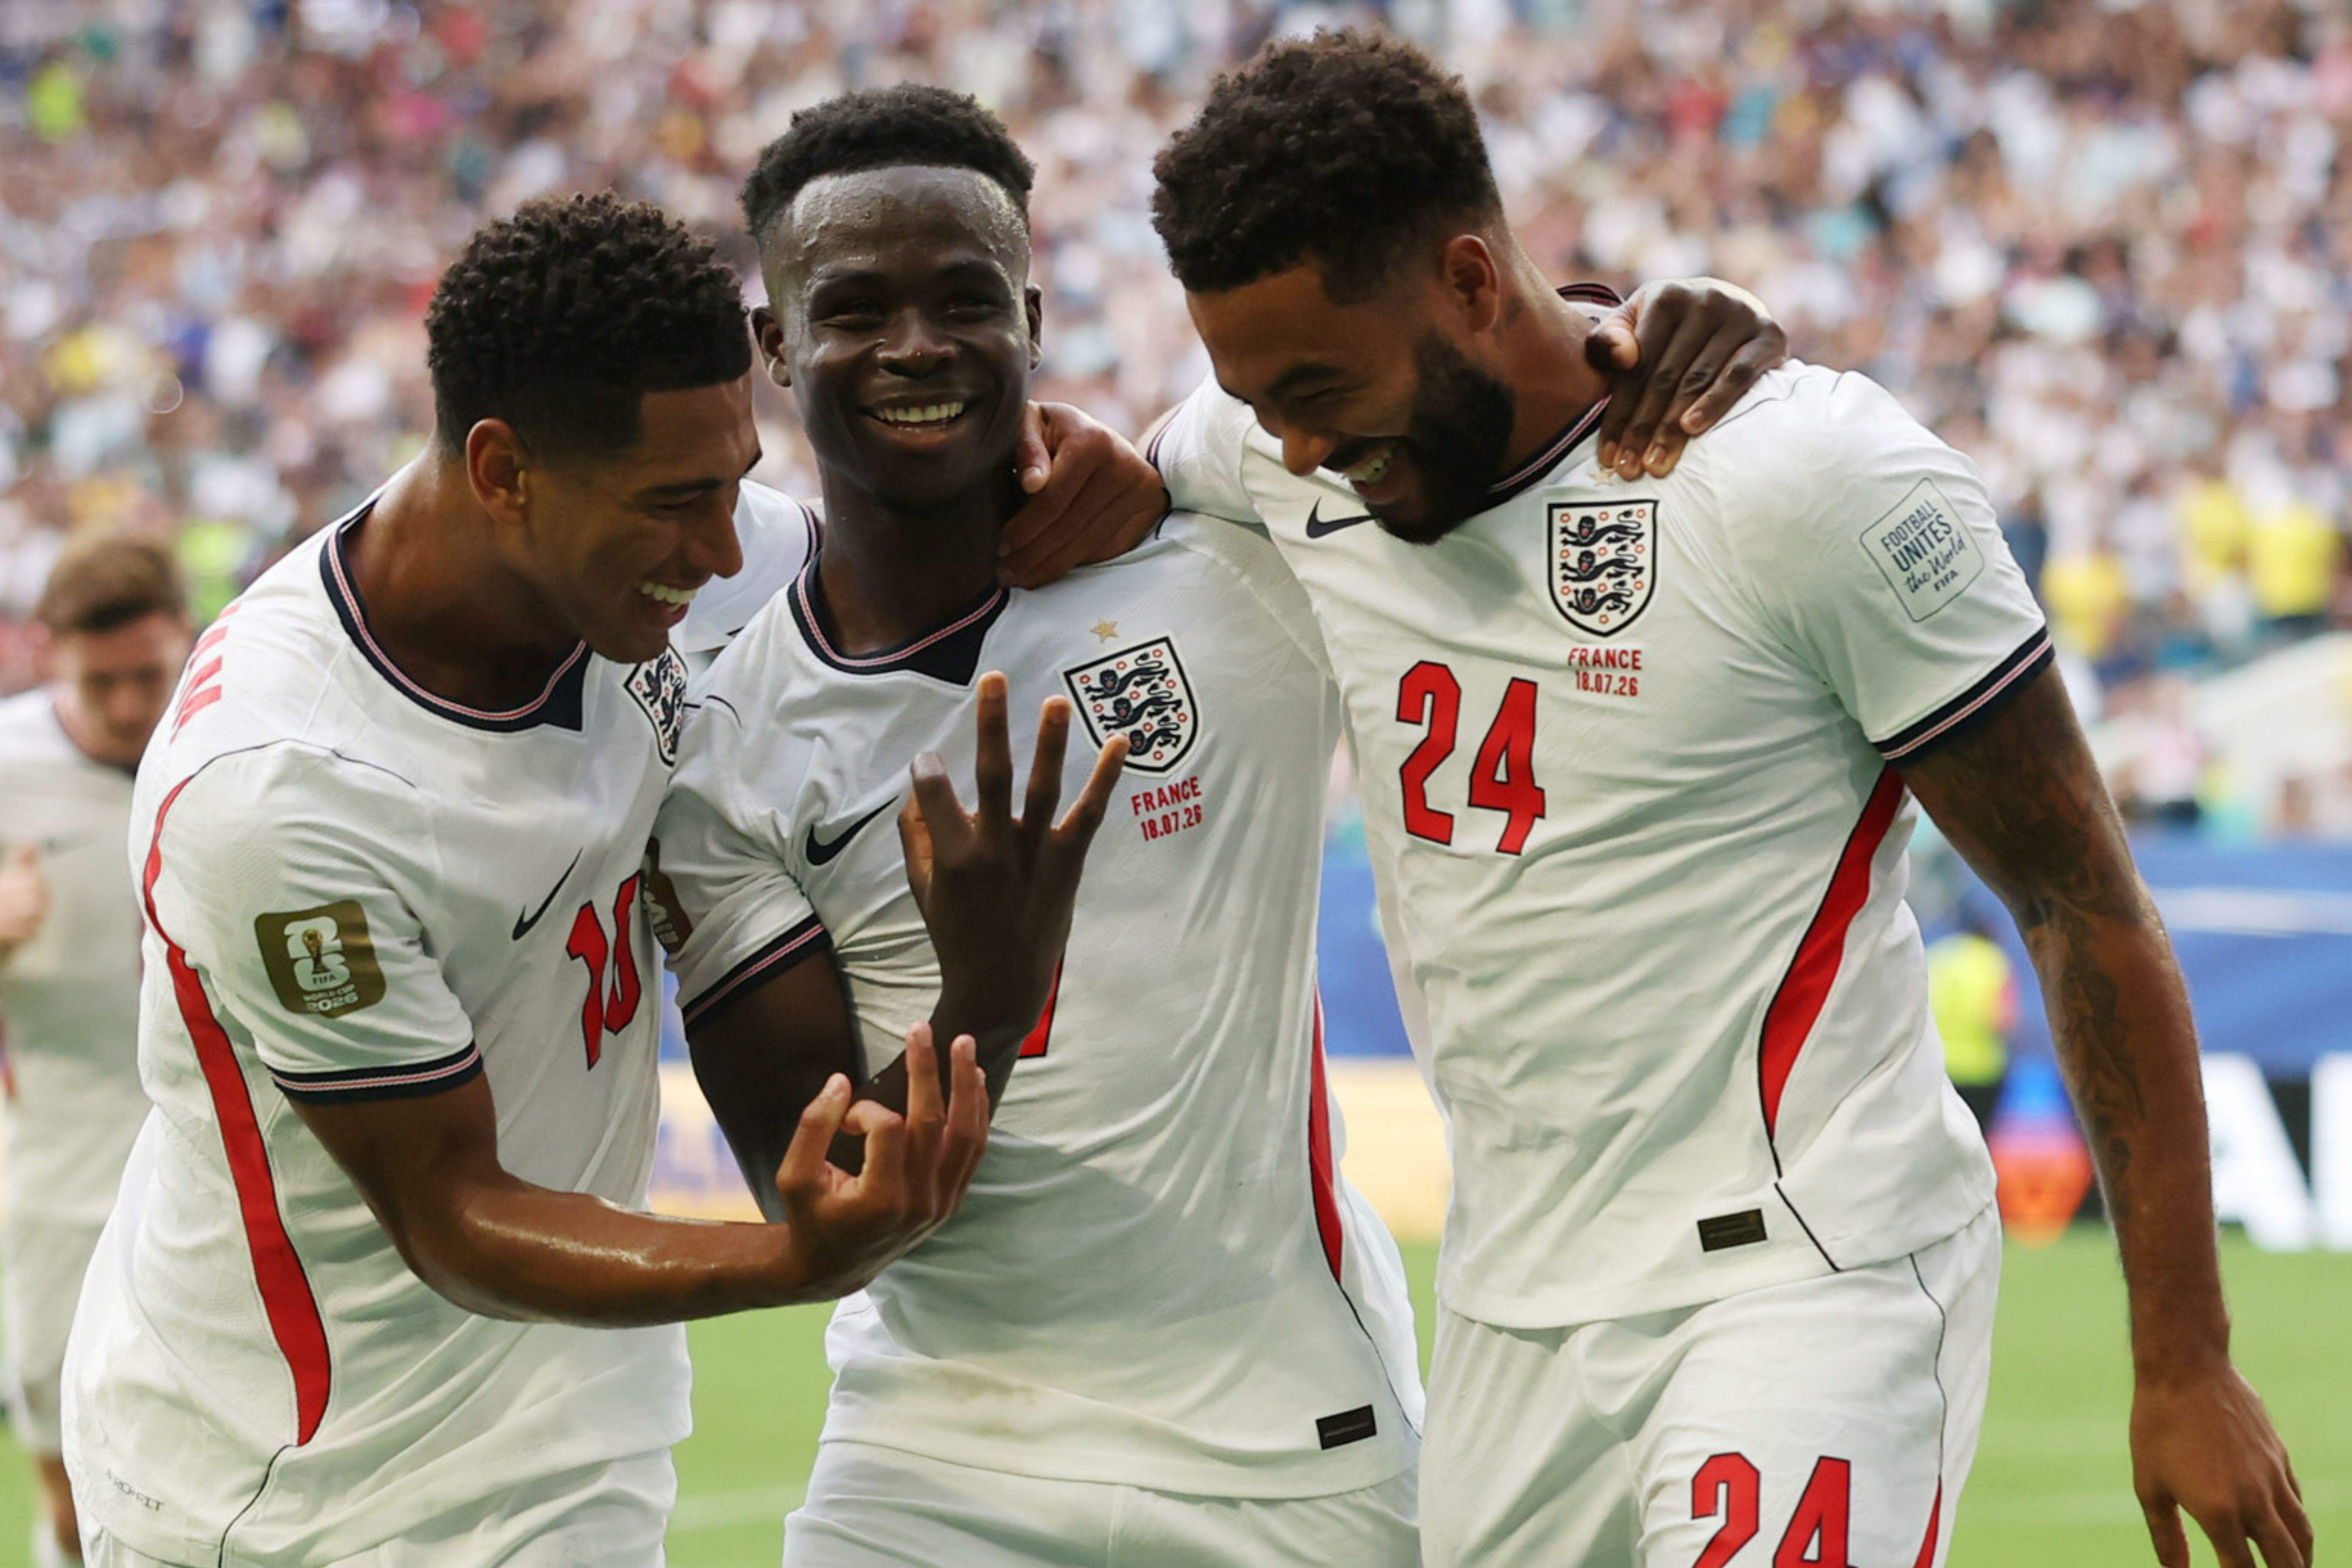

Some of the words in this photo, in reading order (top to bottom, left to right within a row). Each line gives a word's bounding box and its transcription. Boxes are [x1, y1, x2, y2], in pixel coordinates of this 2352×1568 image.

[1880, 499, 1937, 552] FOOTBALL
[1892, 514, 1951, 571] UNITES
[1904, 572, 1931, 593] the
[1927, 531, 1967, 575] World
[1934, 569, 1958, 592] FIFA
[1568, 648, 1642, 671] FRANCE
[1575, 670, 1638, 697] 18.07.26
[1396, 660, 1545, 855] 24
[1131, 776, 1202, 816] FRANCE
[1141, 804, 1202, 841] 18.07.26
[313, 974, 336, 984] FIFA
[566, 869, 641, 1071] 10
[307, 992, 359, 1011] 2026
[1691, 1451, 1857, 1568] 24
